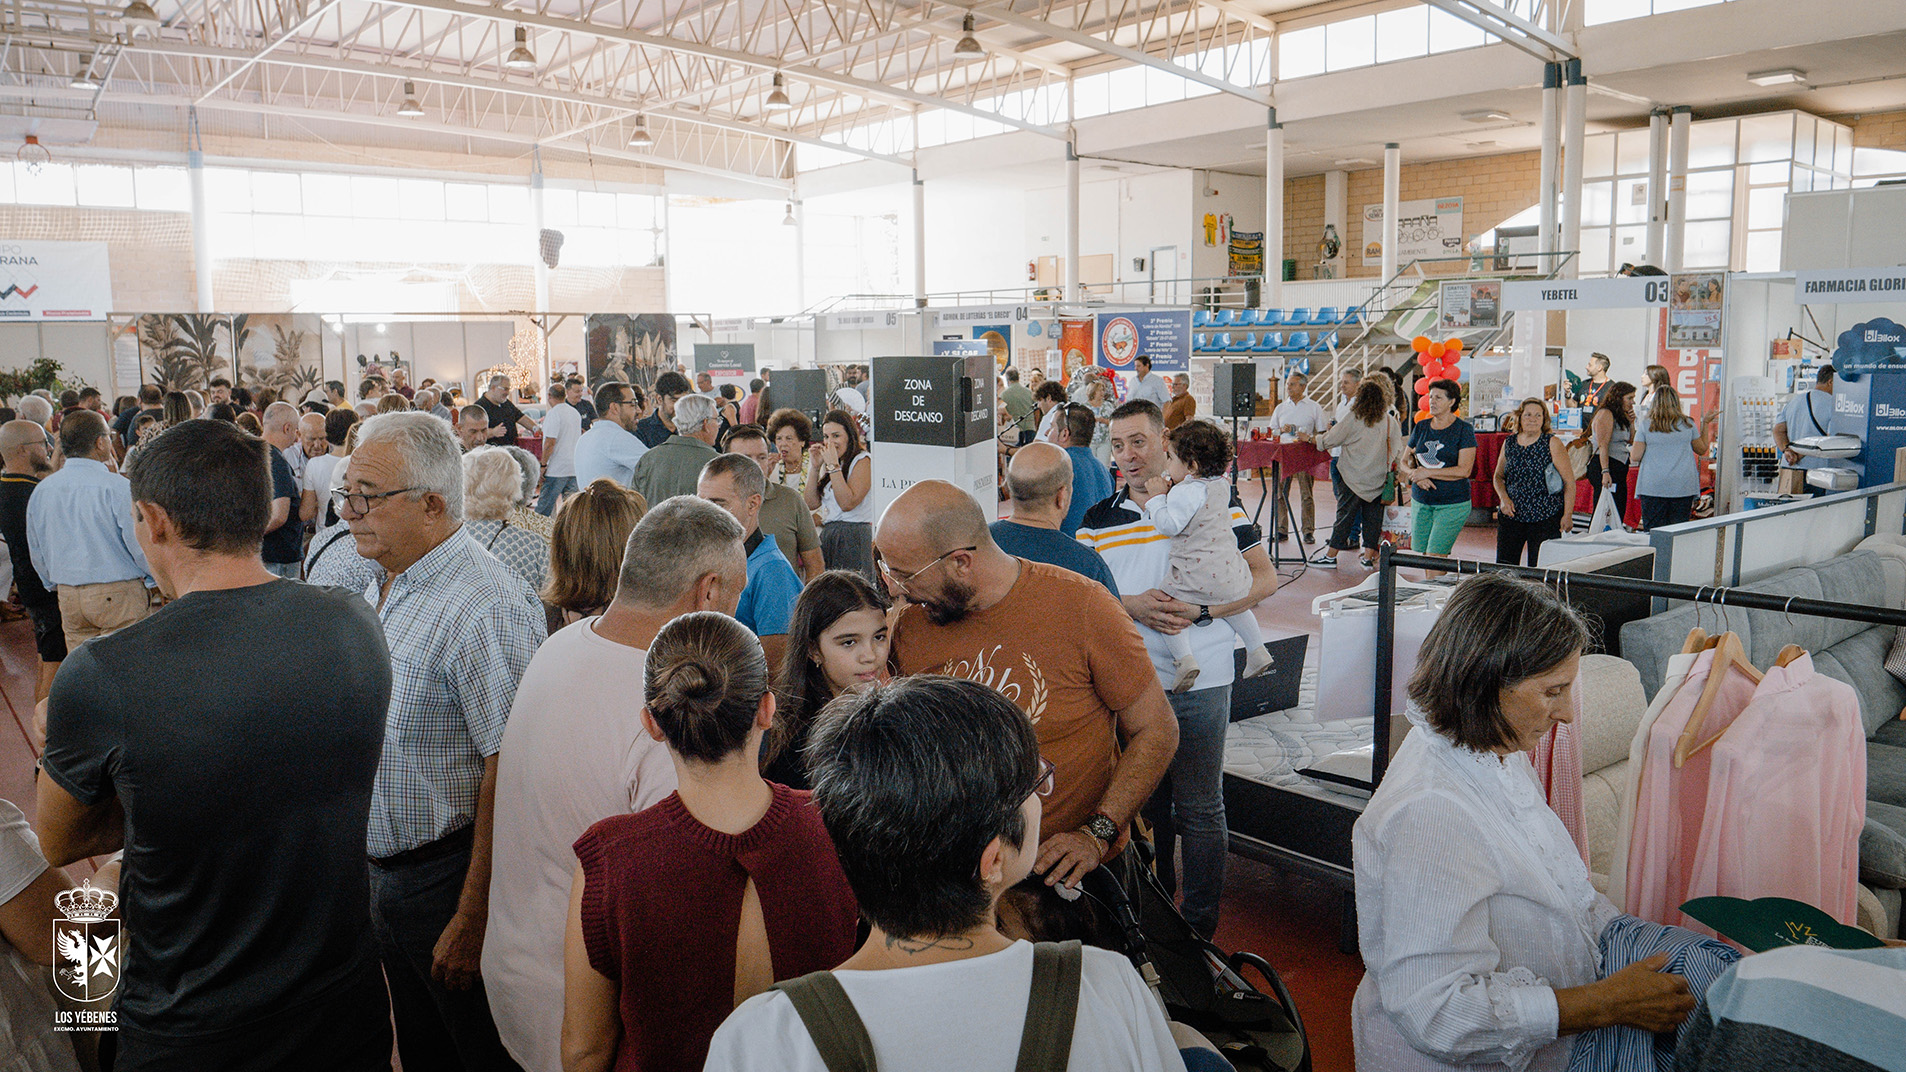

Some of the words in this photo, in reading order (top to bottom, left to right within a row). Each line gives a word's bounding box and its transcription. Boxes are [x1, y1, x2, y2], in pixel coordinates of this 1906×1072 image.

[1366, 247, 1381, 255] RAM
[1541, 289, 1578, 300] YEBETEL
[1645, 281, 1668, 302] 03
[1805, 279, 1866, 293] FARMACIA
[886, 312, 897, 326] 05
[1016, 306, 1028, 321] 04
[904, 379, 932, 390] ZONA
[912, 395, 925, 406] DE
[894, 410, 943, 423] DESCANSO
[882, 477, 897, 488] LA
